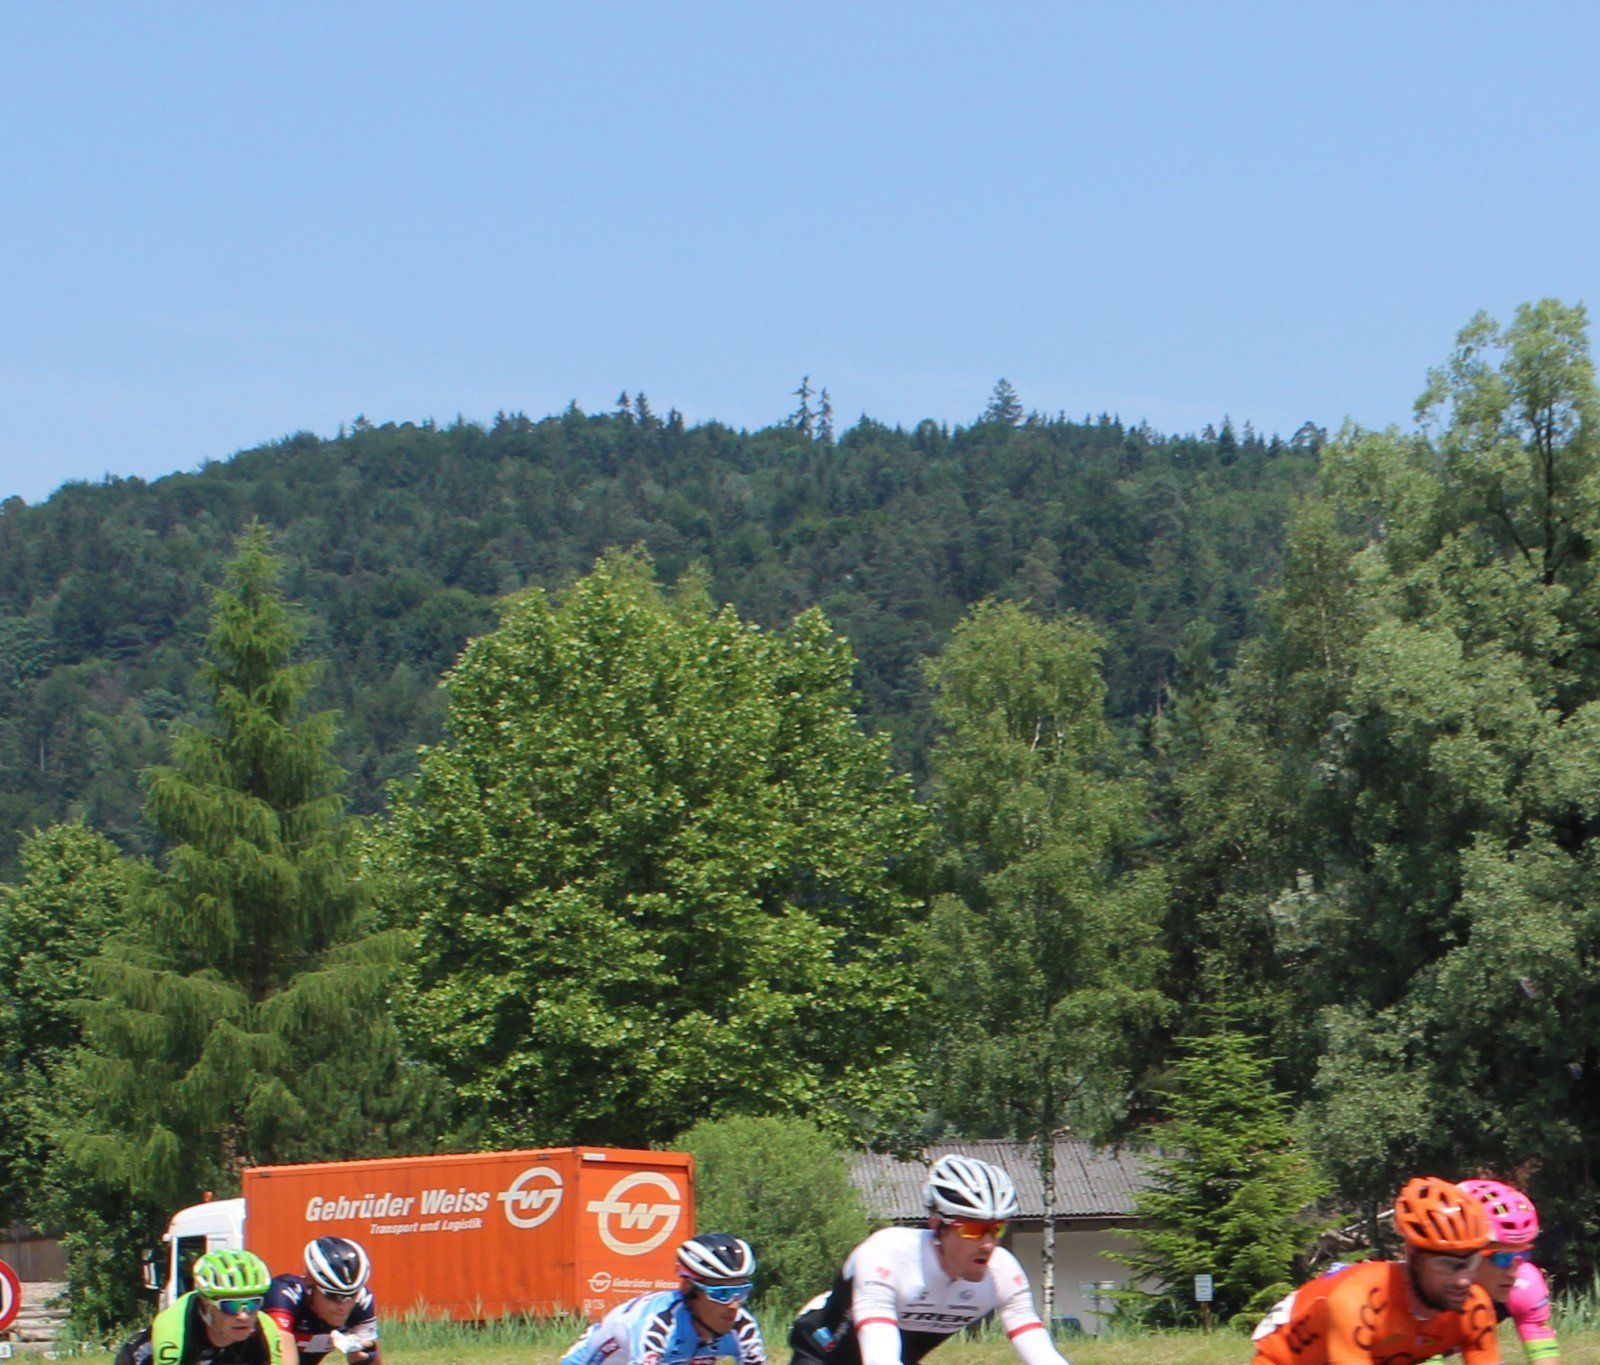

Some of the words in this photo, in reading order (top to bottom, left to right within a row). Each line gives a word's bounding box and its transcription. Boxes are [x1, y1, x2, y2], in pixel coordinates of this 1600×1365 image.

[305, 1192, 415, 1222] Gebrüder
[420, 1188, 491, 1215] Weiss
[370, 1222, 418, 1235] Transport
[420, 1220, 440, 1232] und
[442, 1218, 483, 1232] Logistik
[901, 1312, 976, 1323] TREK
